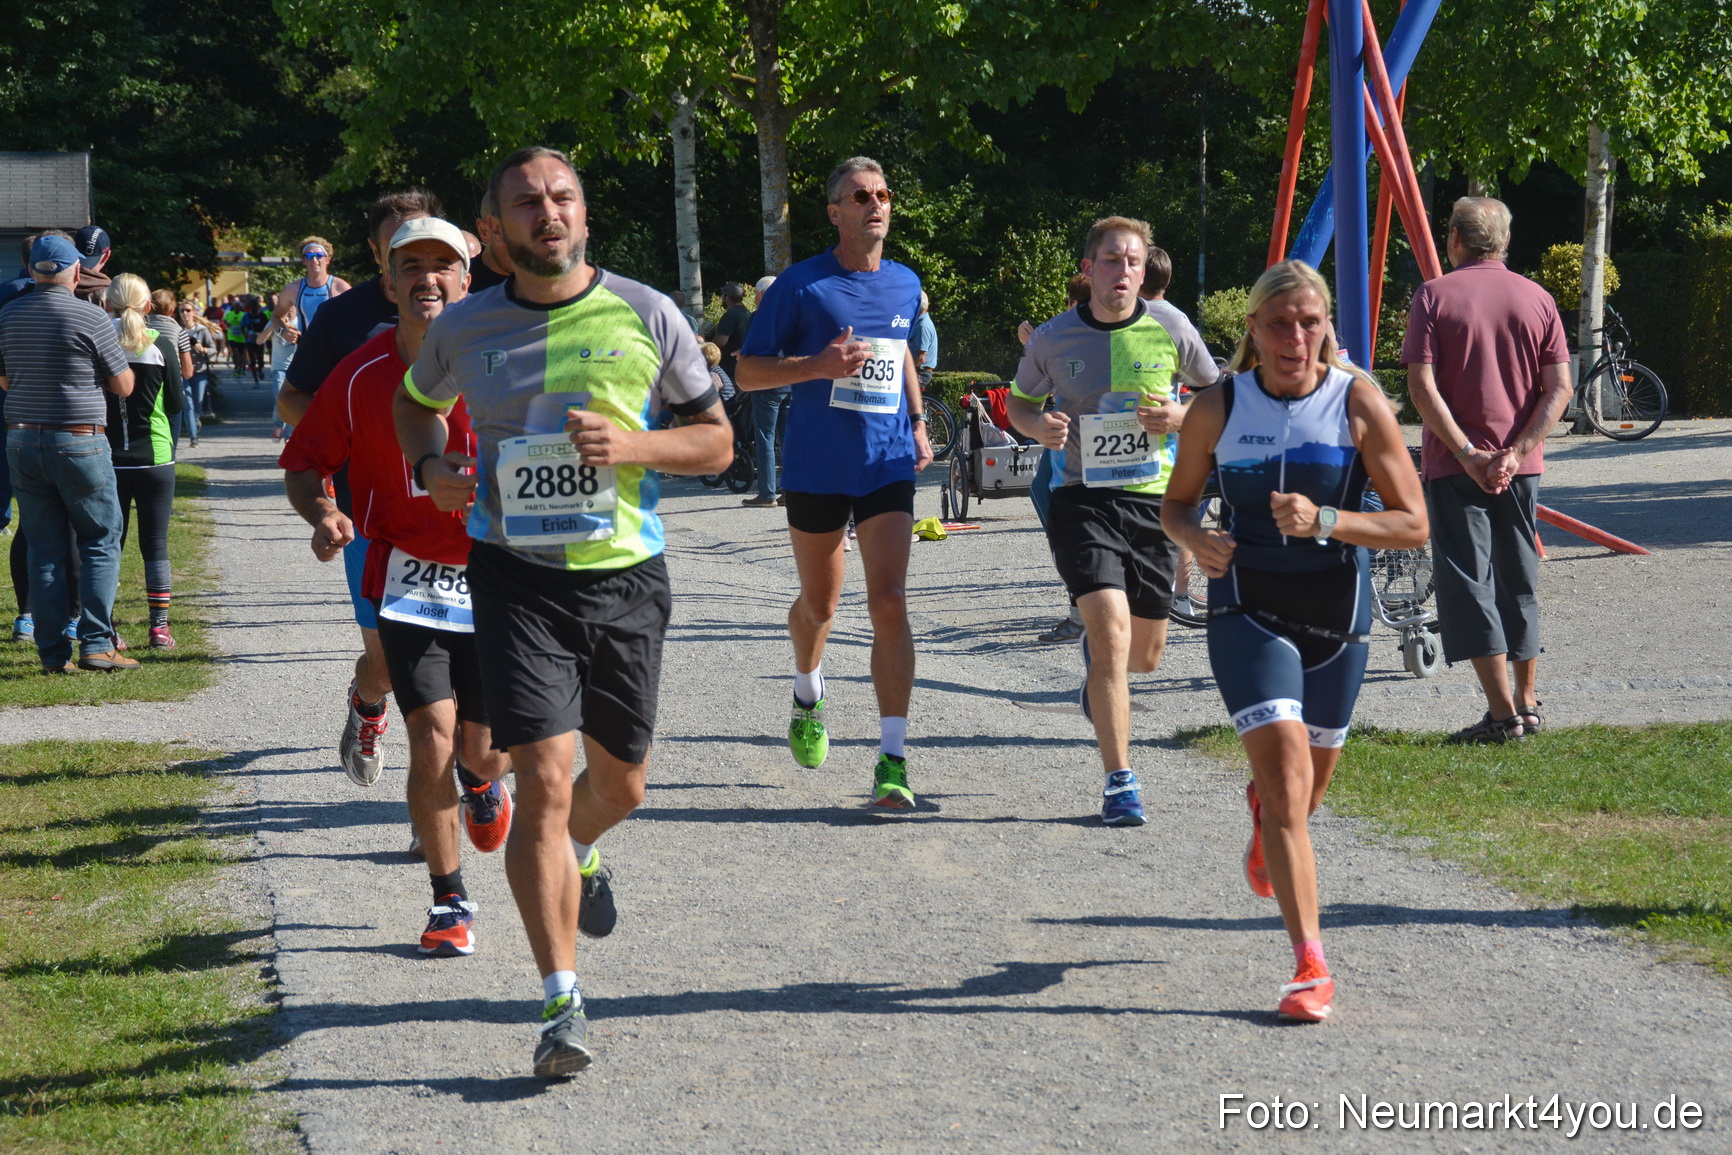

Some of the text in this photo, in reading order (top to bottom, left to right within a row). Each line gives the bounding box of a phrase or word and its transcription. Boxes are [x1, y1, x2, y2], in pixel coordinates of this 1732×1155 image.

[891, 314, 909, 328] asics
[850, 358, 894, 381] 635
[853, 391, 887, 404] Thomas
[1093, 431, 1150, 457] 2234
[1238, 435, 1276, 445] ATSV
[1111, 468, 1137, 478] Peter
[515, 463, 599, 499] 2888
[549, 502, 584, 510] Neumarkt
[541, 517, 577, 532] Erich
[401, 559, 471, 595] 2458
[405, 589, 457, 603] PARTL Neumarkt
[416, 603, 450, 619] Josef
[1236, 704, 1277, 729] ATSV
